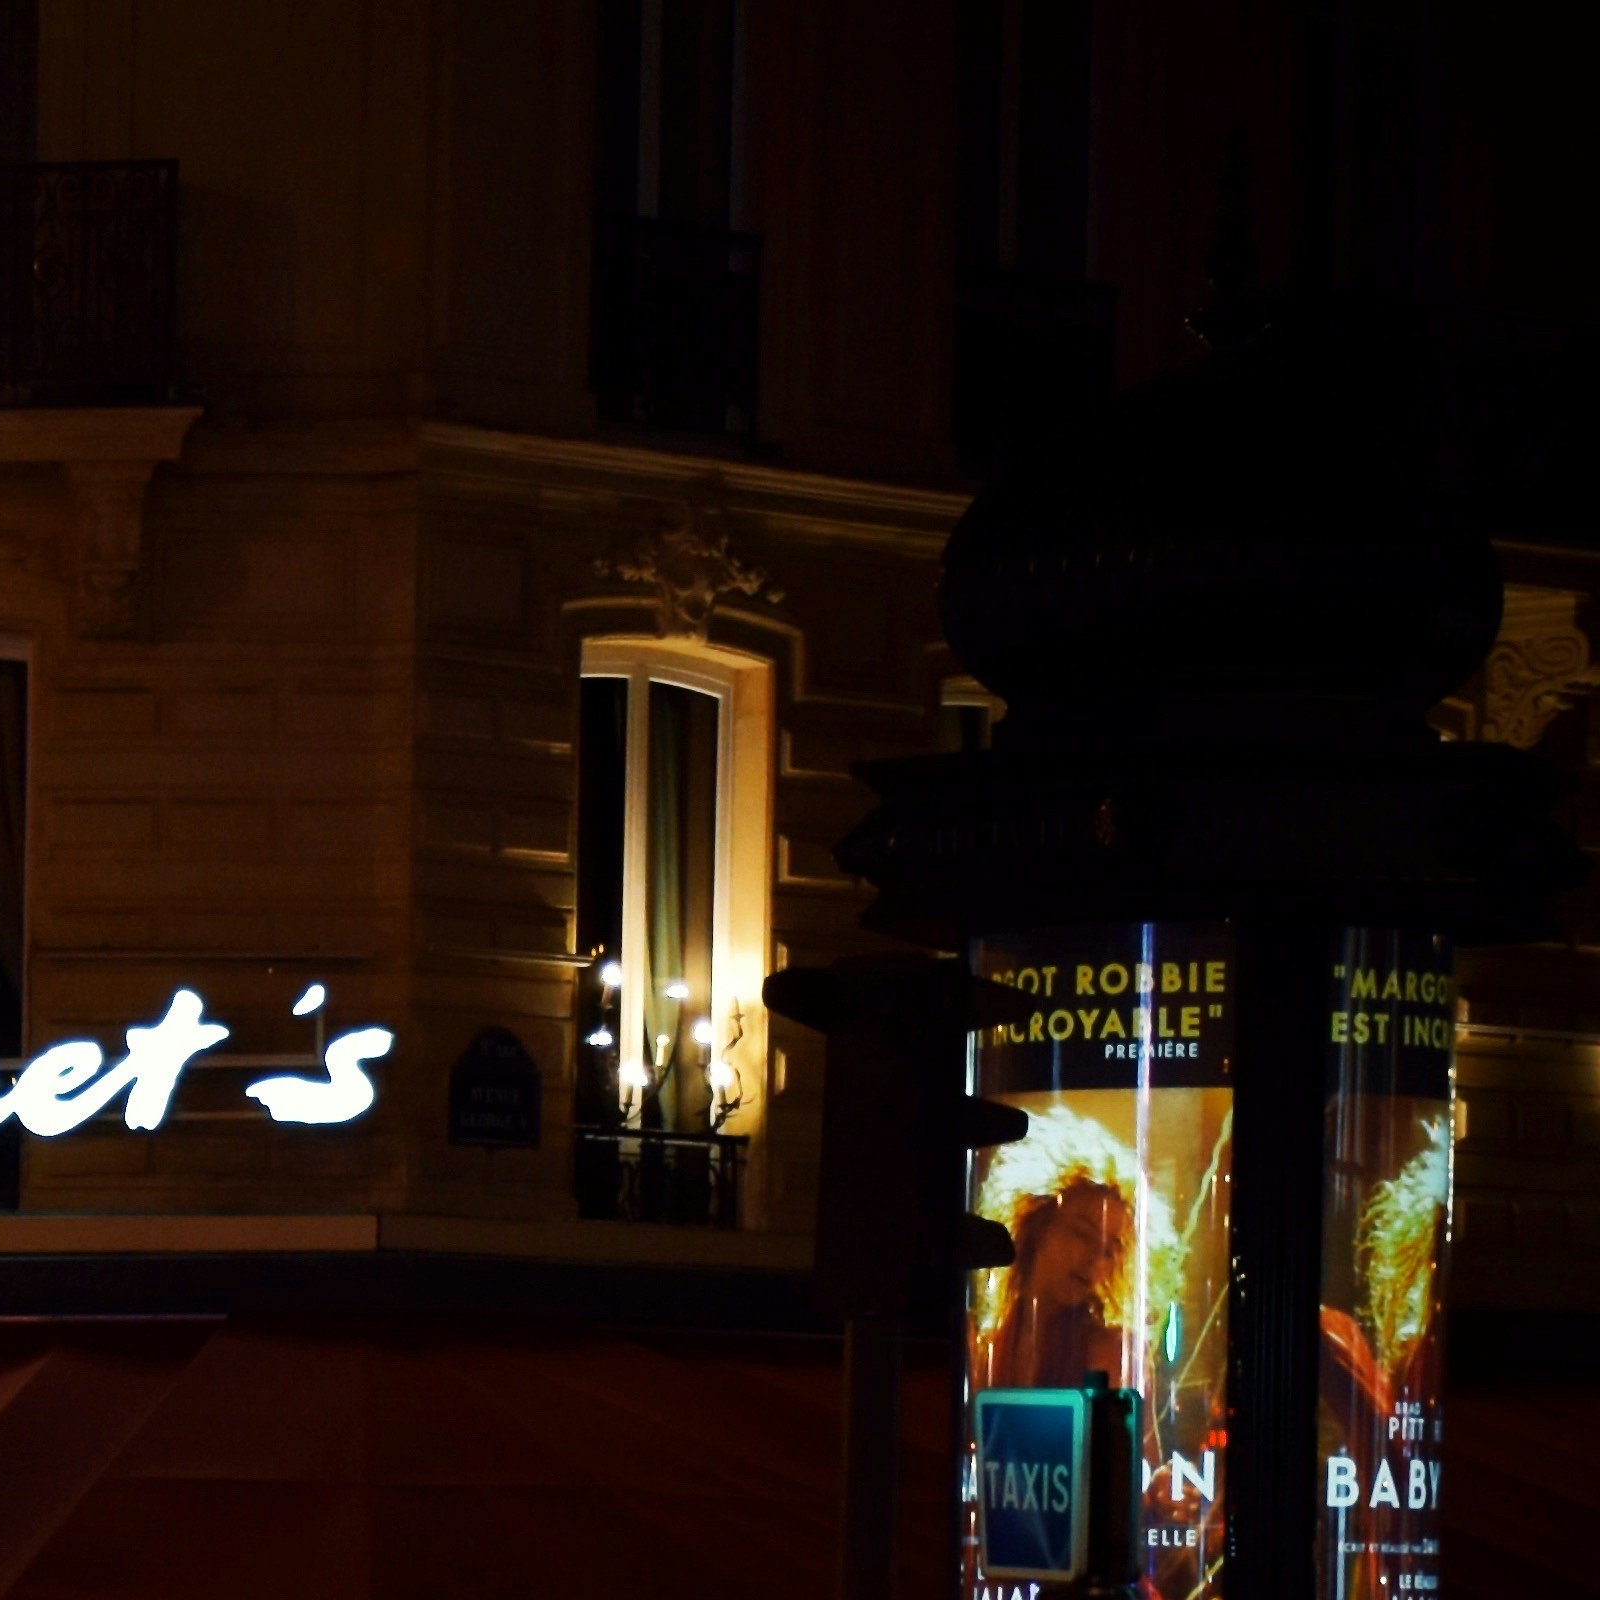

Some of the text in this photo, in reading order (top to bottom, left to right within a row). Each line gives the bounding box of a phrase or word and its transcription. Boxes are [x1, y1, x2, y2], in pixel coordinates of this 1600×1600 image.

[1075, 962, 1226, 996] ROBBIE
[1331, 1011, 1390, 1044] EST
[1104, 1040, 1199, 1059] PREMIÈRE
[1388, 1416, 1425, 1441] PITT
[985, 1460, 1070, 1513] TAXIS
